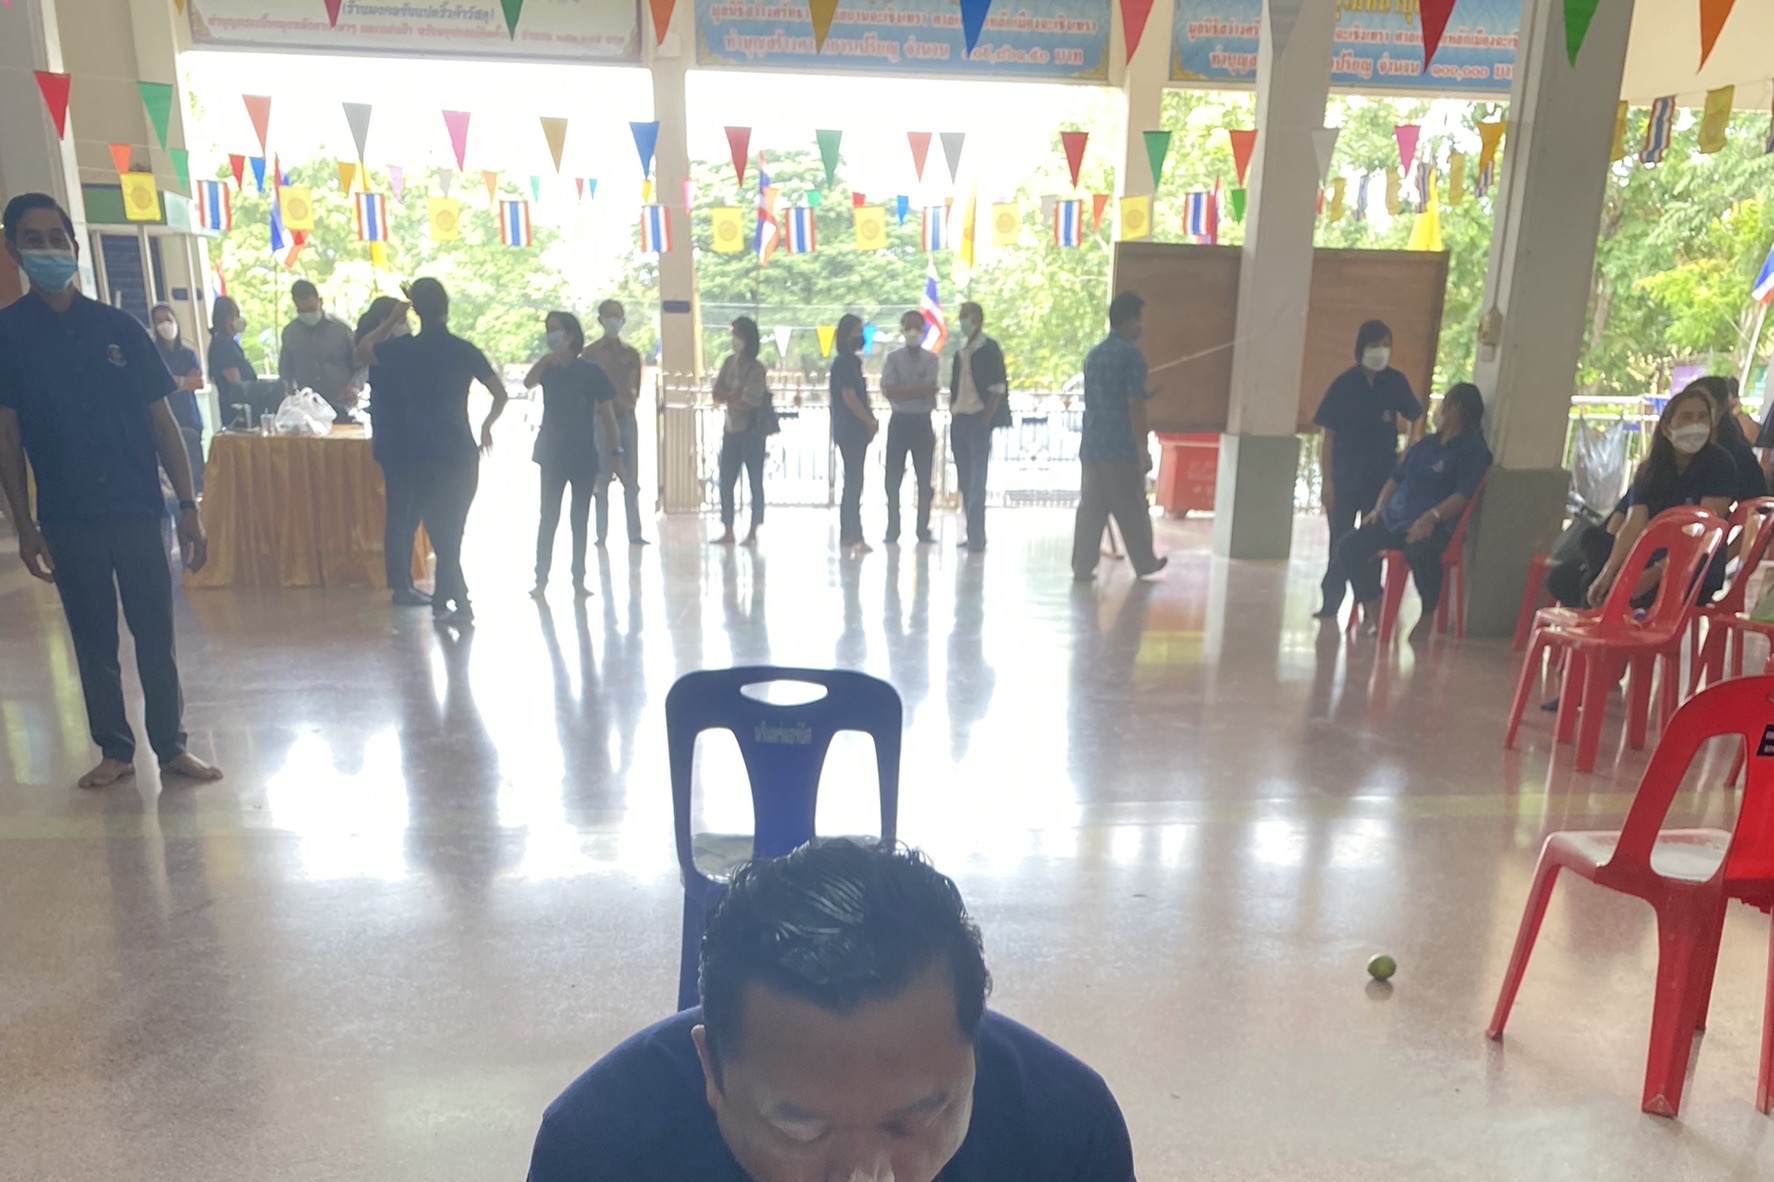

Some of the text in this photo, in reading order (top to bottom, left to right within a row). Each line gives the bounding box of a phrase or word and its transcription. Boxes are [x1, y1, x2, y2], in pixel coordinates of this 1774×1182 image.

[905, 37, 950, 59] จำนวน
[1055, 47, 1084, 65] บาท
[1377, 51, 1421, 76] จำนวน
[1494, 62, 1514, 80] บา
